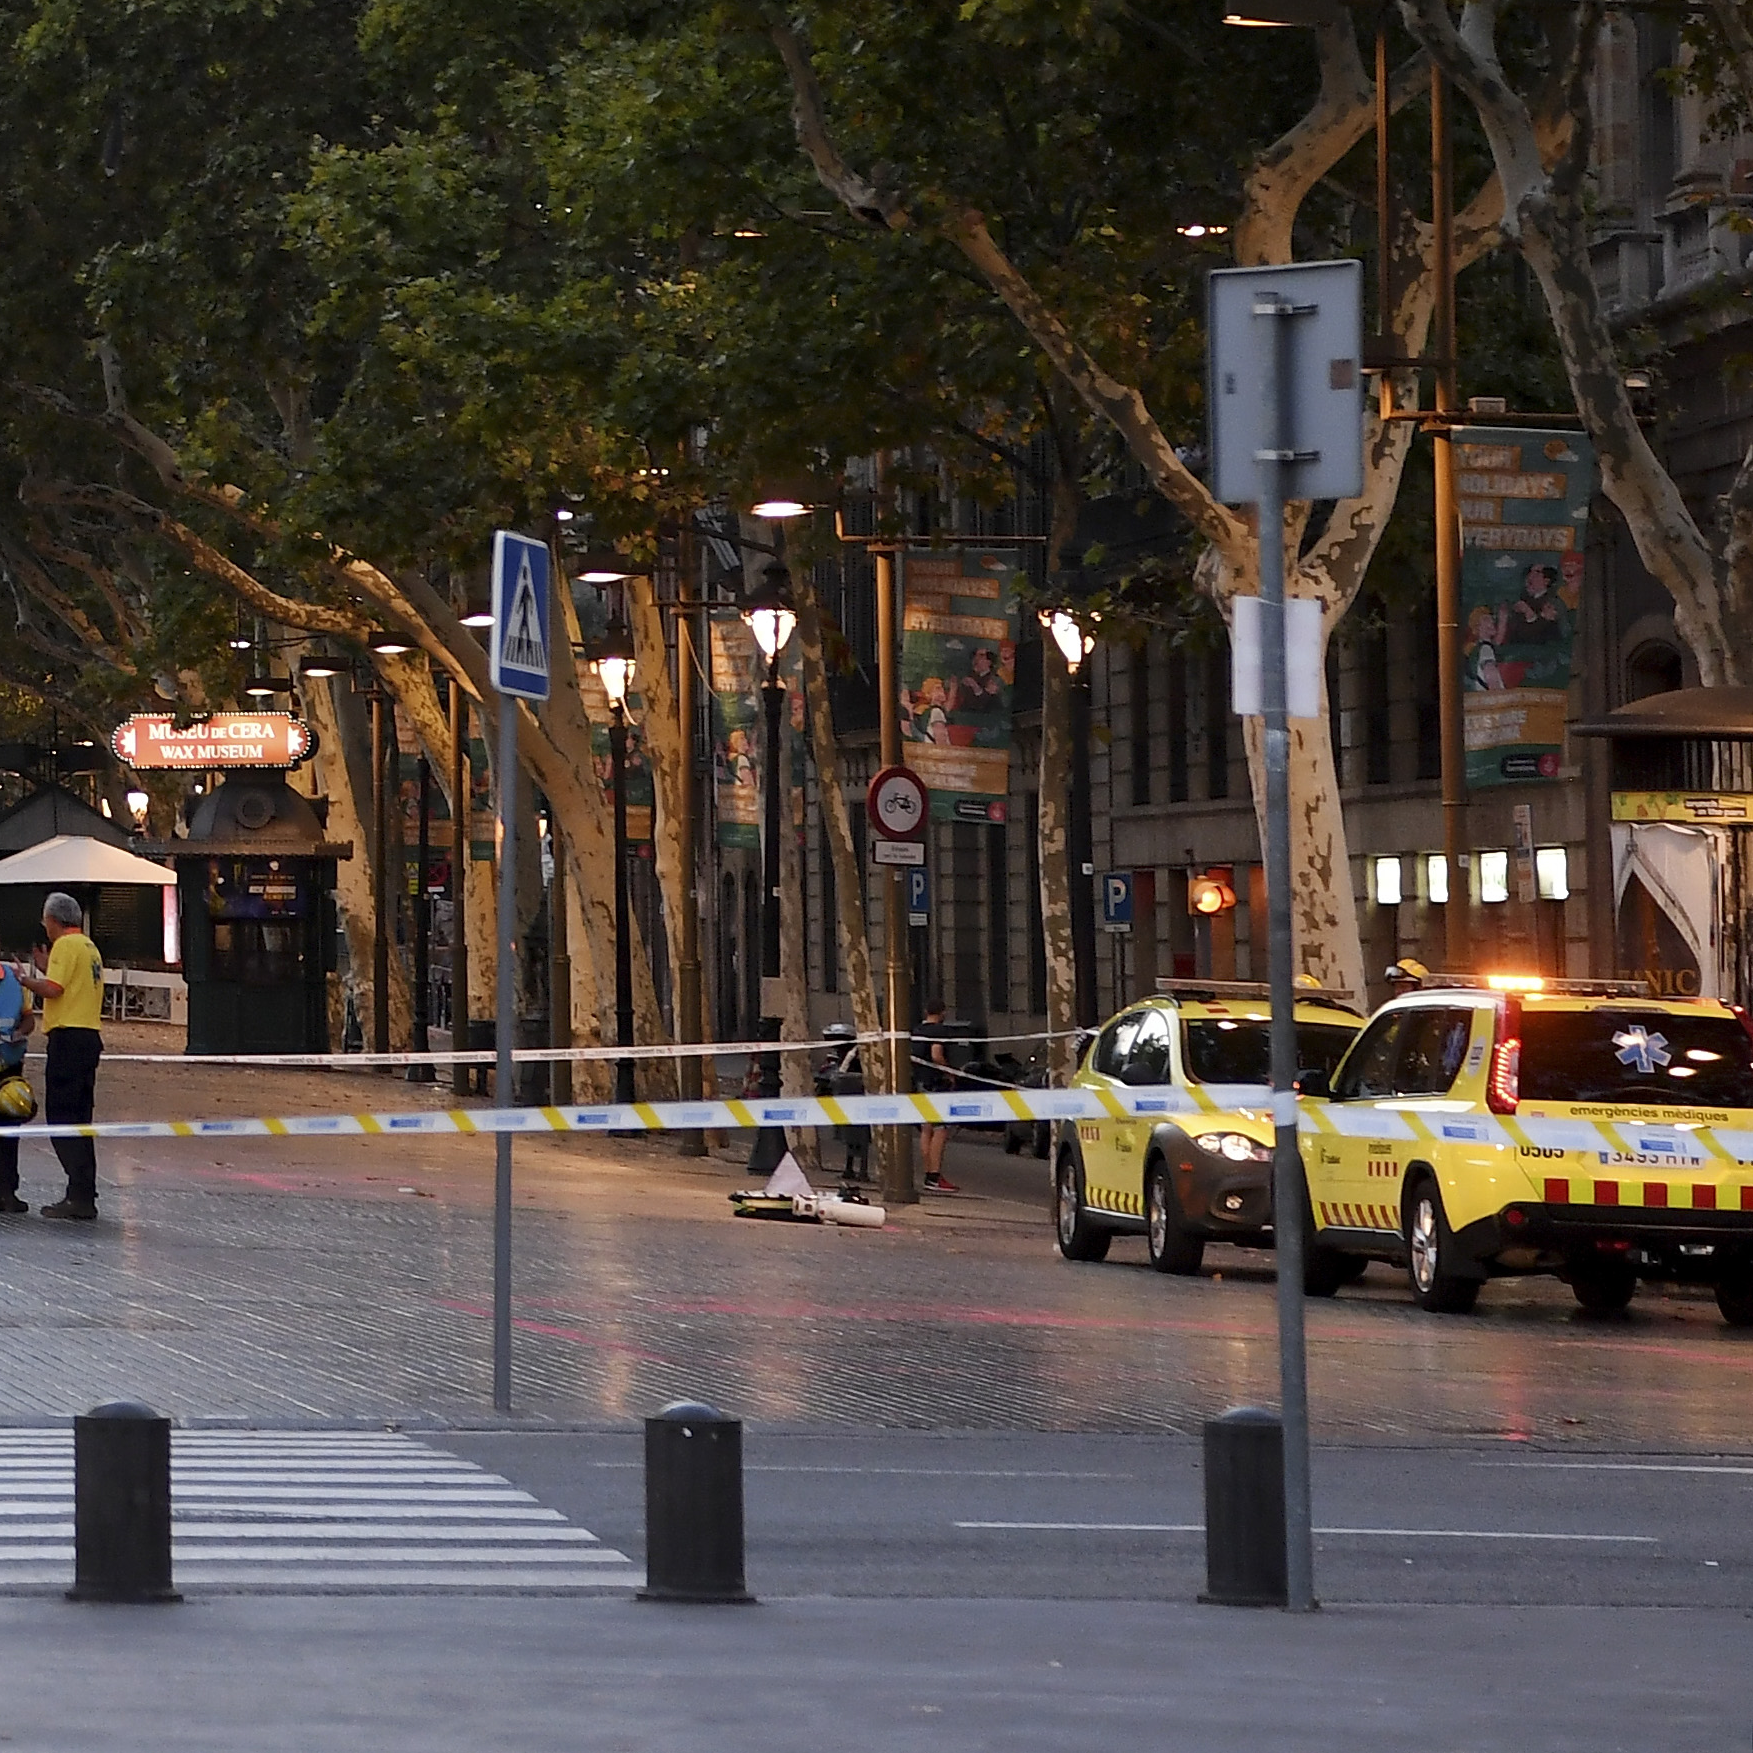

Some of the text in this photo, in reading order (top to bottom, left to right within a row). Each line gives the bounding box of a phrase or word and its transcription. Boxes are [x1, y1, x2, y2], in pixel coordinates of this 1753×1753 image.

[228, 722, 275, 740] CERA
[159, 745, 264, 760] WAX MUSEUM
[911, 873, 924, 906] P
[1108, 878, 1127, 917] P
[1570, 1105, 1729, 1122] emergències mèdiques
